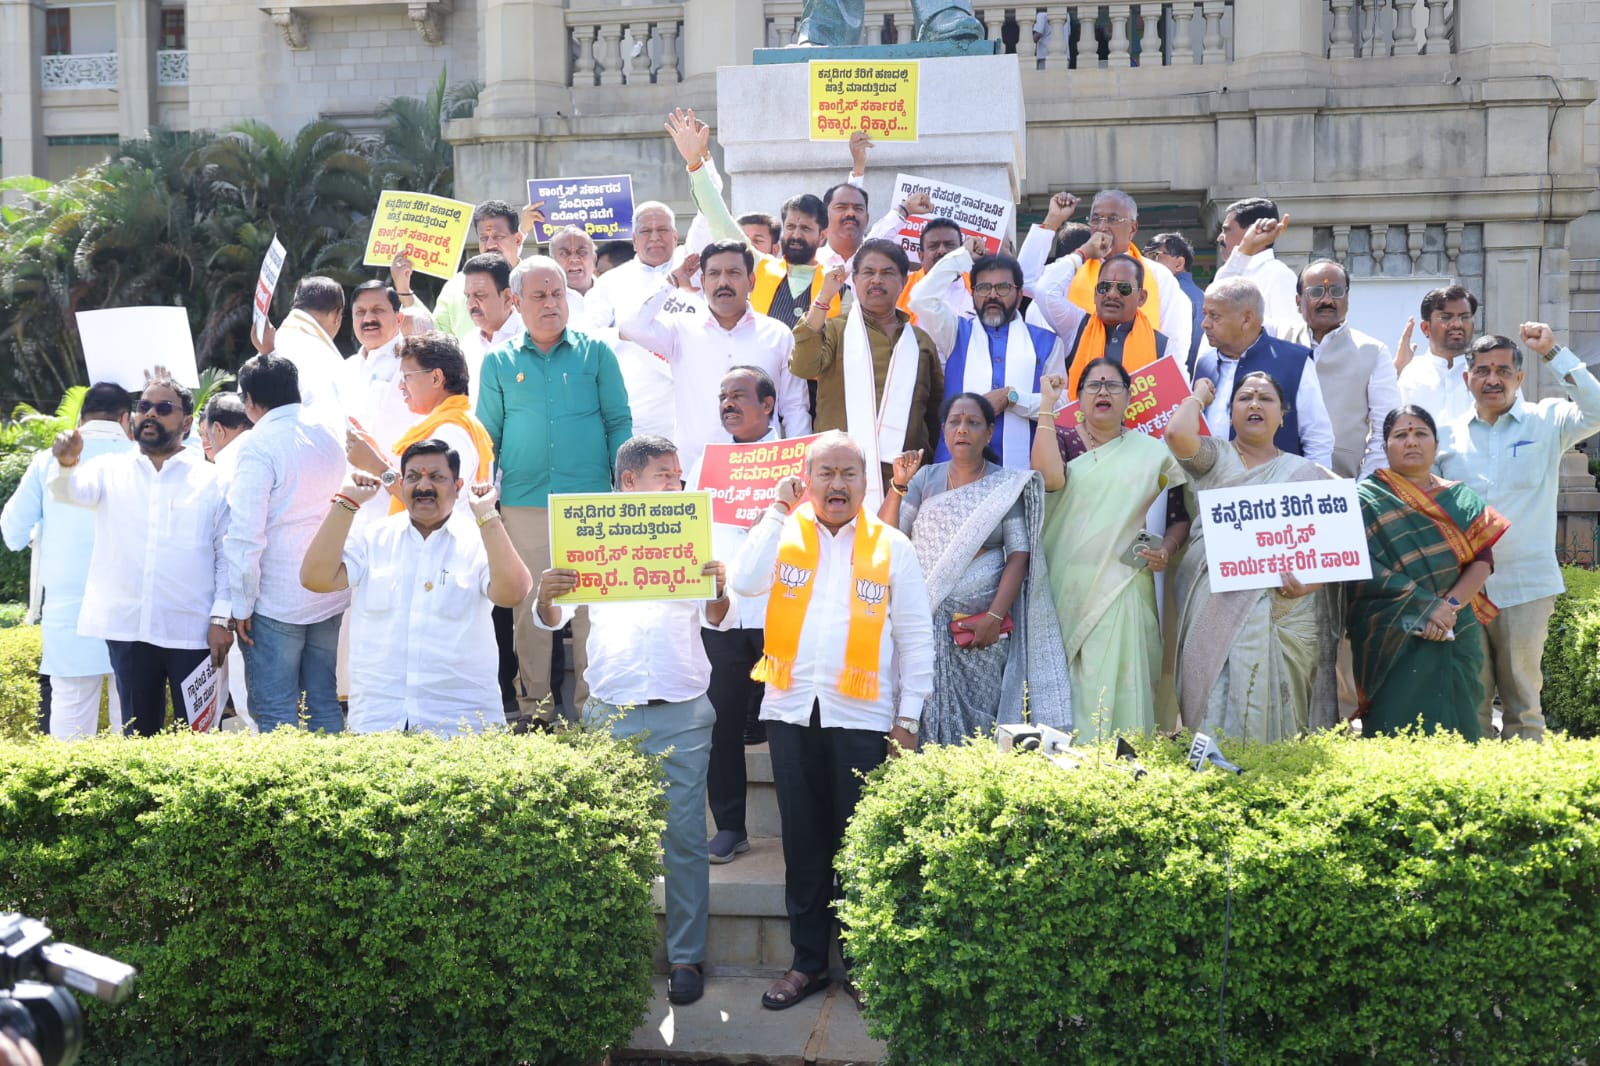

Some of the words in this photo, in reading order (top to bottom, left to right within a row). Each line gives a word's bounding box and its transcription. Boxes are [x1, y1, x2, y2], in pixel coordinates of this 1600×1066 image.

[818, 68, 852, 82] ಕನ್ನಡಿಗರ
[854, 68, 873, 79] ತೆರಿಗೆ
[875, 69, 909, 82] ಹಣದಲ್ಲಿ
[825, 81, 844, 95] ಜಾತ್ರೆ
[846, 83, 897, 96] ಮಾಡುತ್ತಿರುವ
[819, 99, 858, 113] ಕಾಂಗ್ರೆಸ್
[860, 99, 906, 117] ಸರ್ಕಾರಕ್ಕೆ
[818, 115, 857, 135] ಧಿಕ್ಕಾರ..
[539, 184, 578, 199] ಕಾಂಗ್ರೆಸ್
[580, 182, 621, 195] ಸರ್ಕಾರದ
[932, 186, 961, 208] ನೆಪದಲ್ಲಿ
[962, 196, 1004, 216] ಸಾರ್ವಜನಿಕ
[385, 199, 411, 212] ಕನ್ನಡಿಗರ
[412, 200, 430, 212] ತೆರಿಗೆ
[430, 204, 462, 223] ಹಣದಲ್ಲಿ
[551, 210, 588, 222] ವಿರೋಧಿ
[589, 208, 614, 220] ನಡೆಗೆ
[559, 197, 604, 212] ಸಂವಿಧಾನ
[402, 212, 448, 228] ಮಾಡುತ್ತಿರುವ
[954, 210, 998, 232] ಮಾಡುತ್ತಿರುವ
[378, 226, 408, 240] ಕಾಂಗ್ರೆಸ್
[408, 229, 451, 254] ಸರ್ಕಾರಕ್ಕೆ
[729, 446, 778, 464] ಜನರಿಗೆ
[730, 459, 802, 480] ಸಮಾಧಾನ
[564, 505, 616, 524] ಕನ್ನಡಿಗರ
[620, 503, 646, 517] ತೆರಿಗೆ
[650, 502, 698, 520] ಹಣದಲ್ಲಿ
[1212, 498, 1276, 530] ಕನ್ನಡಿಗರ
[1280, 494, 1314, 516] ತೆರಿಗೆ
[1318, 494, 1348, 514] ಹಣ
[576, 521, 606, 539] ಜಾತ್ರೆ
[609, 522, 682, 540] ಮಾಡುತ್ತಿರುವ
[1256, 523, 1316, 550] ಕಾಂಗ್ರೆಸ್
[566, 545, 627, 566] ಕಾಂಗ್ರೆಸ್
[632, 542, 698, 566] ಸರ್ಕಾರಕ್ಕೆ
[1220, 548, 1317, 578] ಕಾರ್ಯಕರ್ತರಿಗೆ
[1321, 549, 1360, 568] ಪಾಲು
[633, 566, 700, 592] ಧಿಕ್ಕಾರ...
